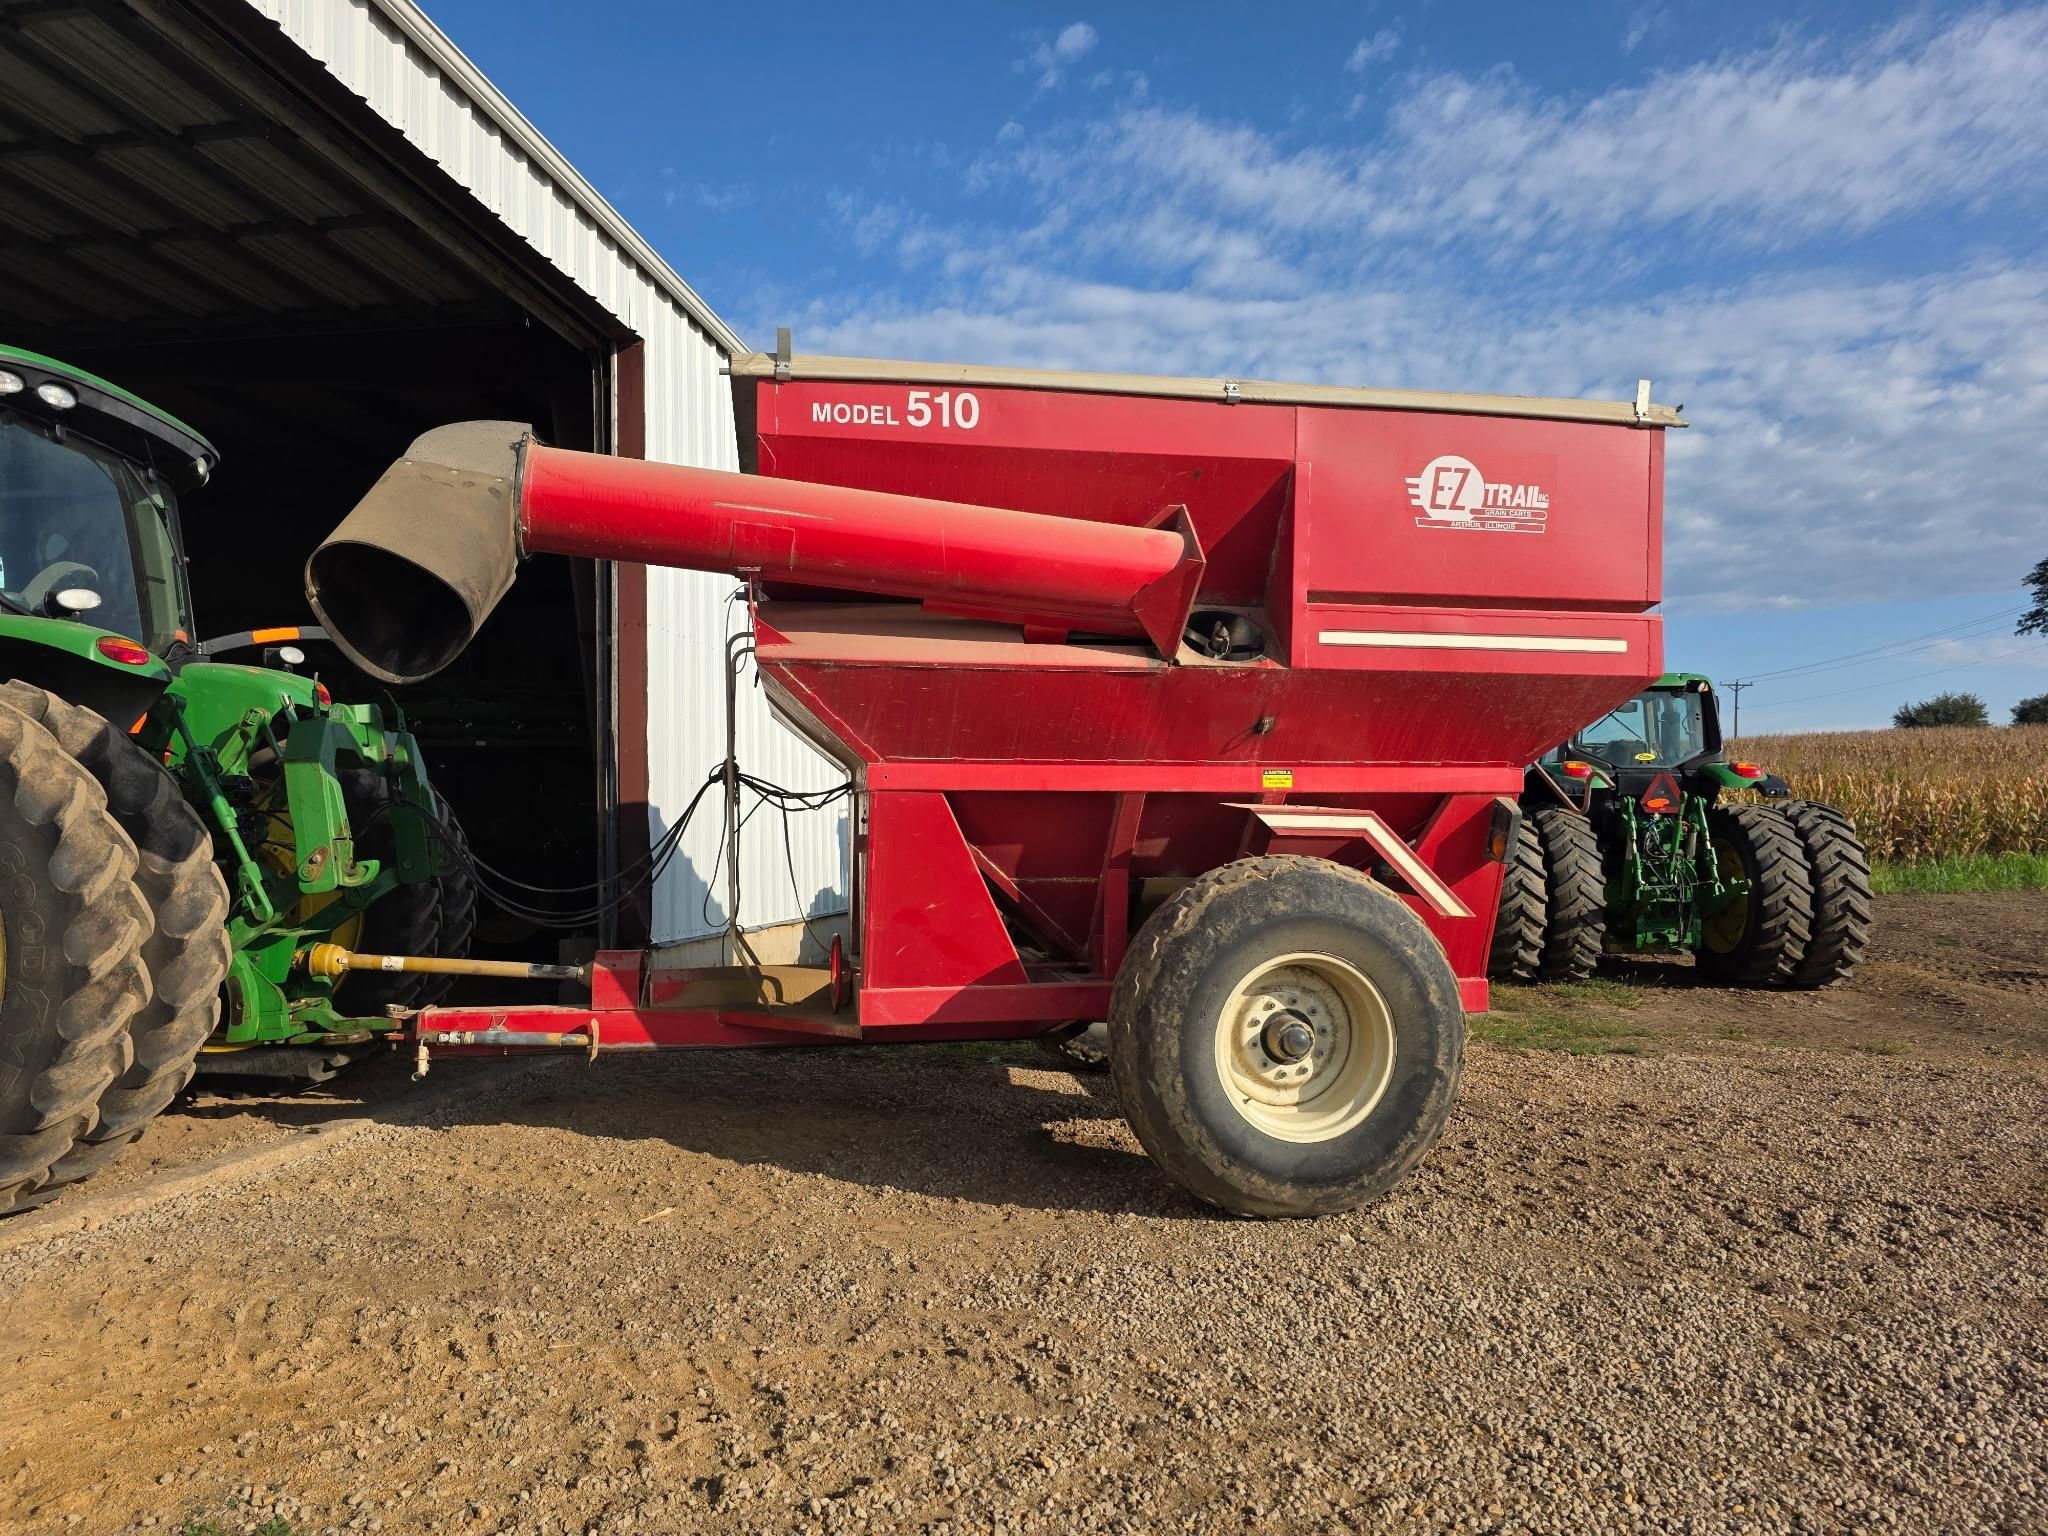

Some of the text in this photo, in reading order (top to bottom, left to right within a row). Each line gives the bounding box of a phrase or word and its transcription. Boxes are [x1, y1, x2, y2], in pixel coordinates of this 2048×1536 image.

[812, 391, 980, 429] MODEL 510
[1484, 483, 1549, 508] TRAIL
[1484, 509, 1532, 518] GRAIN CARTS
[1485, 522, 1516, 530] ILLINOIS
